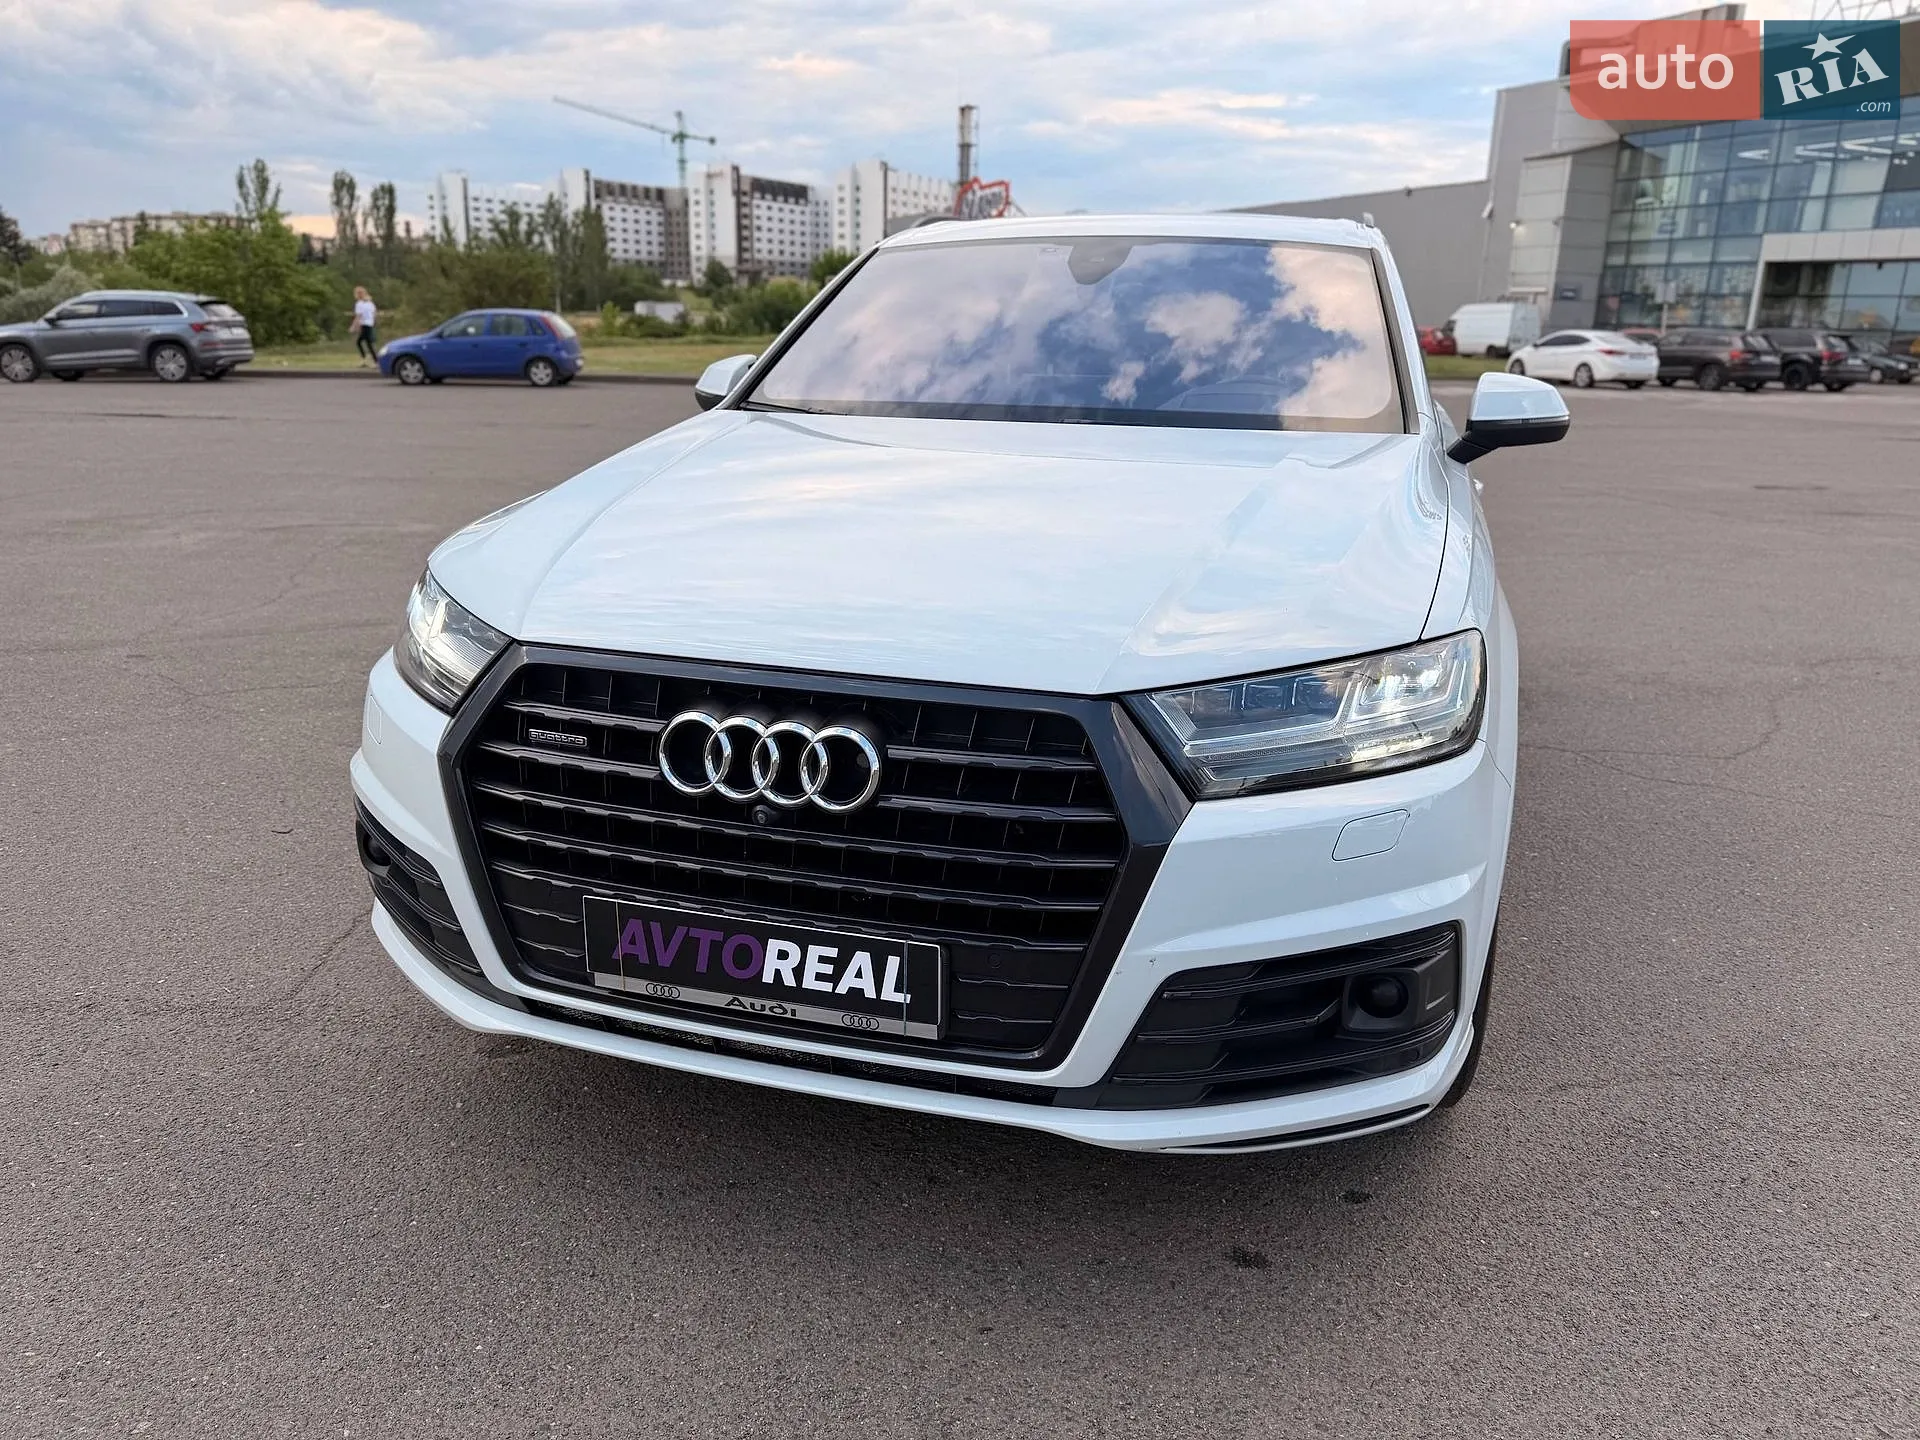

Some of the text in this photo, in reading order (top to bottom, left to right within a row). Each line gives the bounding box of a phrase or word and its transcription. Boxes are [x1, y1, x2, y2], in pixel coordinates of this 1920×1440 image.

[529, 730, 585, 745] quattro
[612, 917, 912, 1004] AVTOREAL
[723, 996, 798, 1018] Audi
